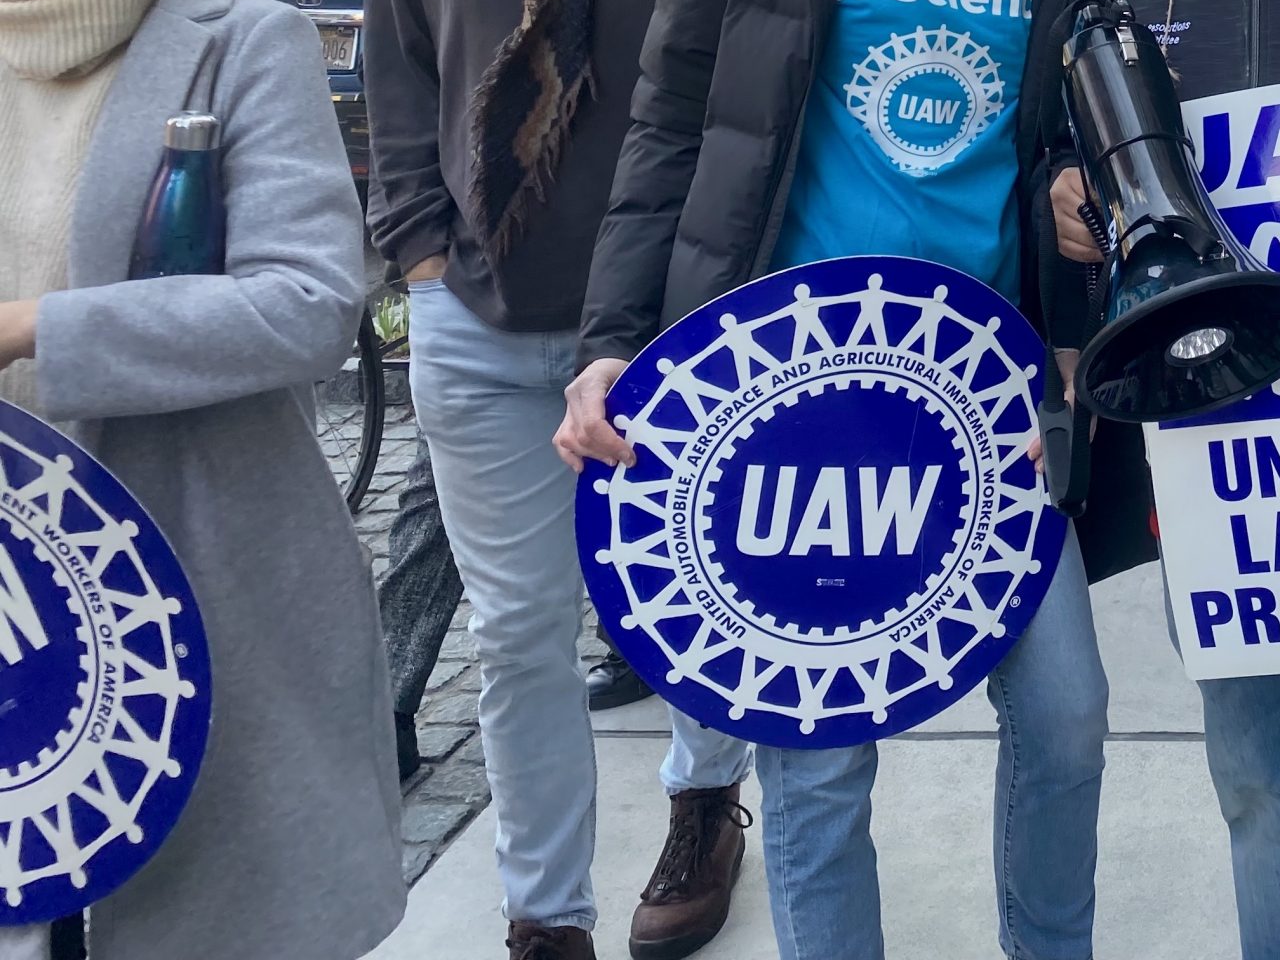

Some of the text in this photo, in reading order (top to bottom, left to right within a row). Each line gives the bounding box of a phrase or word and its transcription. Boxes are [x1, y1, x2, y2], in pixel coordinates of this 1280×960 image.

[897, 93, 962, 125] UAW
[672, 351, 995, 643] UNITED AUTOMOBILE, AEROSPACE AND AGRICULTURAL IMPLEMENT WORKERS OF AMERICA
[736, 464, 943, 557] UAW
[42, 523, 106, 615] WORKERS
[98, 623, 116, 651] OF
[87, 660, 117, 744] AMERICA
